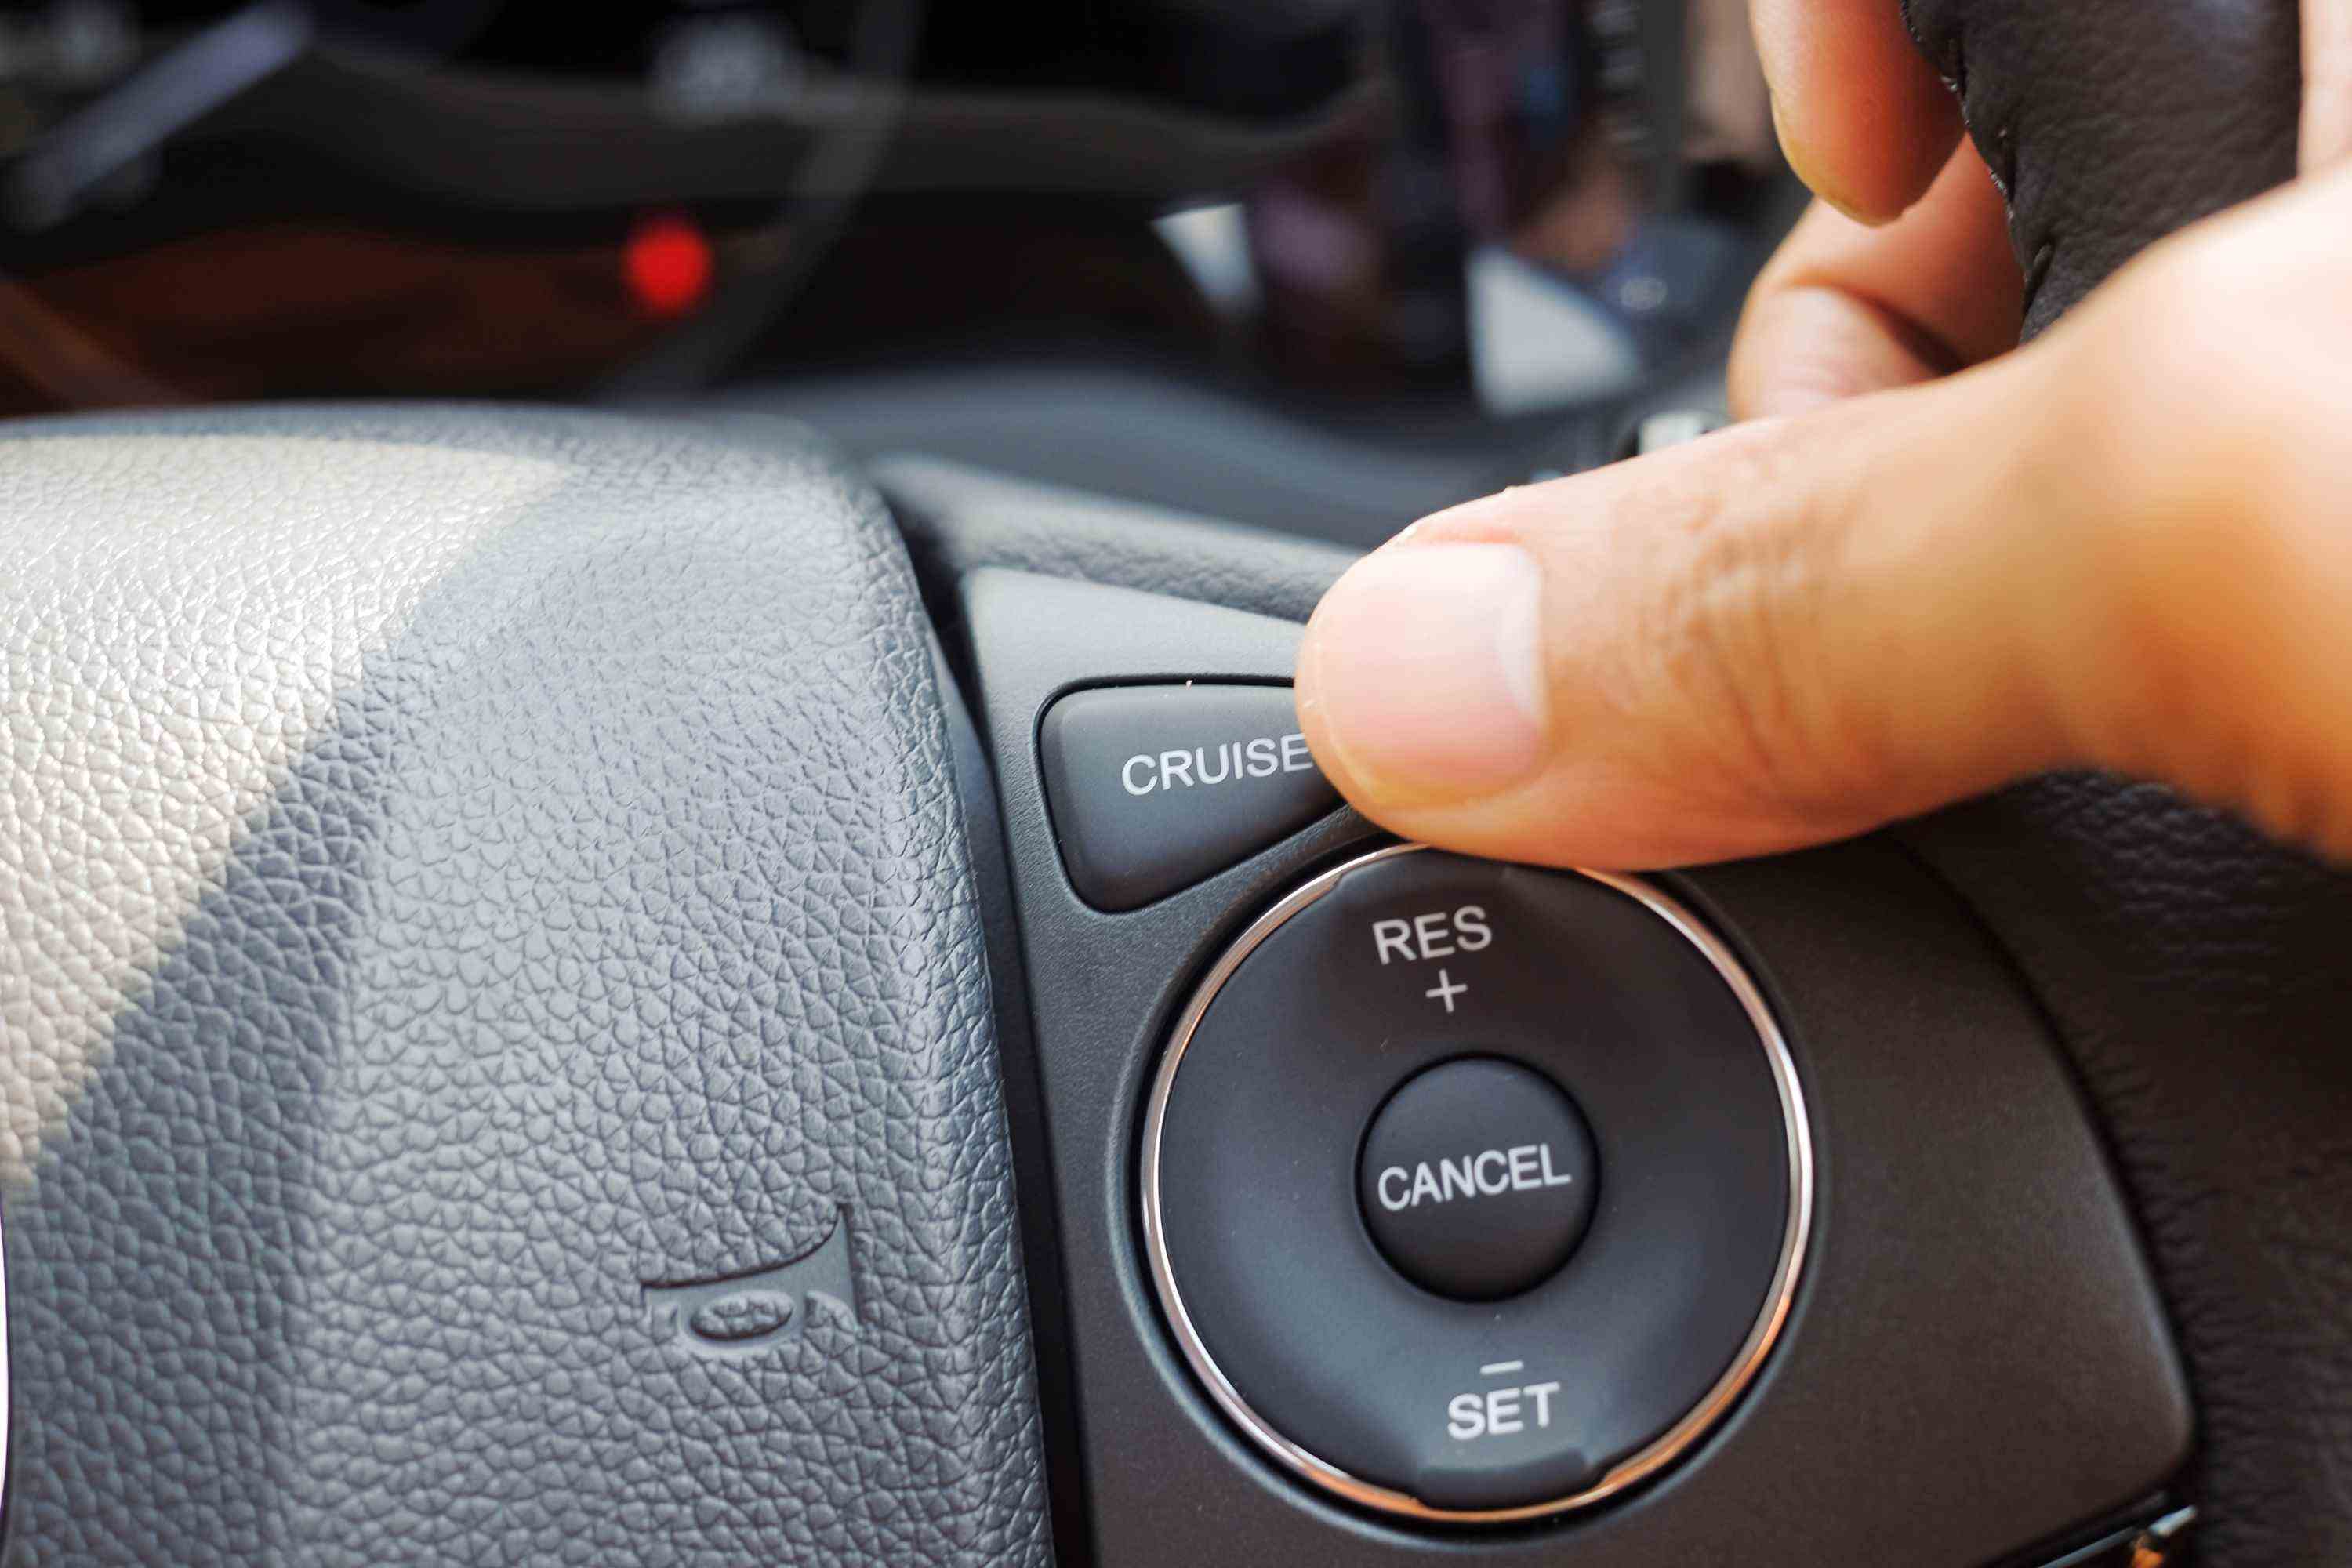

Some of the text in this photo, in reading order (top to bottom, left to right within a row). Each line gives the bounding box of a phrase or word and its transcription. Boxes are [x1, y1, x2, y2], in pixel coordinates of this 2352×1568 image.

[1122, 733, 1313, 795] CRUISE
[1373, 906, 1492, 965] RES
[1378, 1143, 1572, 1211] CANCEL
[1447, 1381, 1560, 1440] SET
